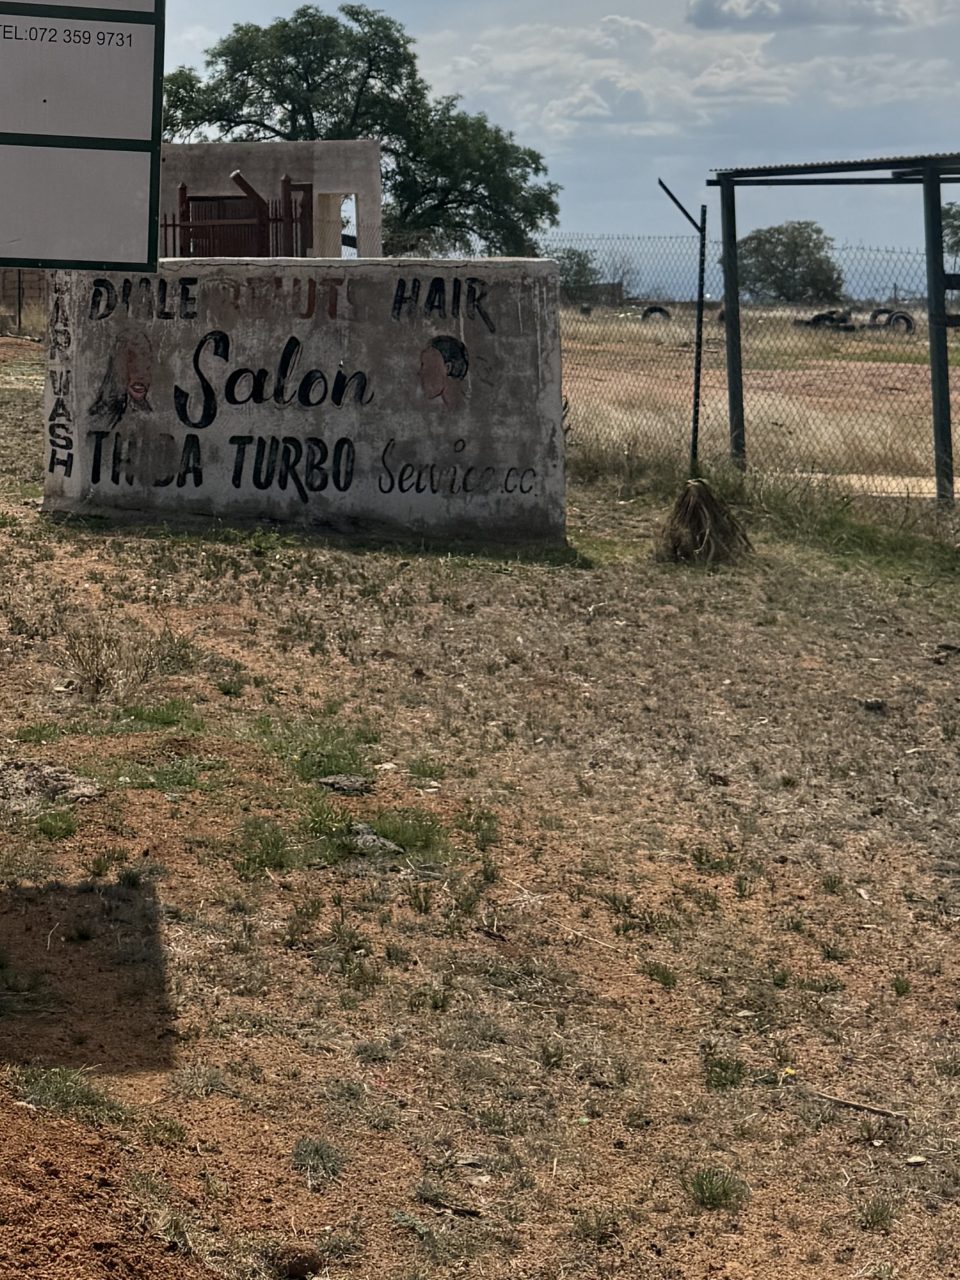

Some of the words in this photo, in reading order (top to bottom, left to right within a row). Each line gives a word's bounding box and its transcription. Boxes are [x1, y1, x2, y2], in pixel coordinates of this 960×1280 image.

[62, 28, 91, 46] 359
[96, 31, 134, 49] 9731
[392, 276, 496, 334] HAIR
[173, 330, 376, 430] Salon
[228, 434, 356, 505] TURBO
